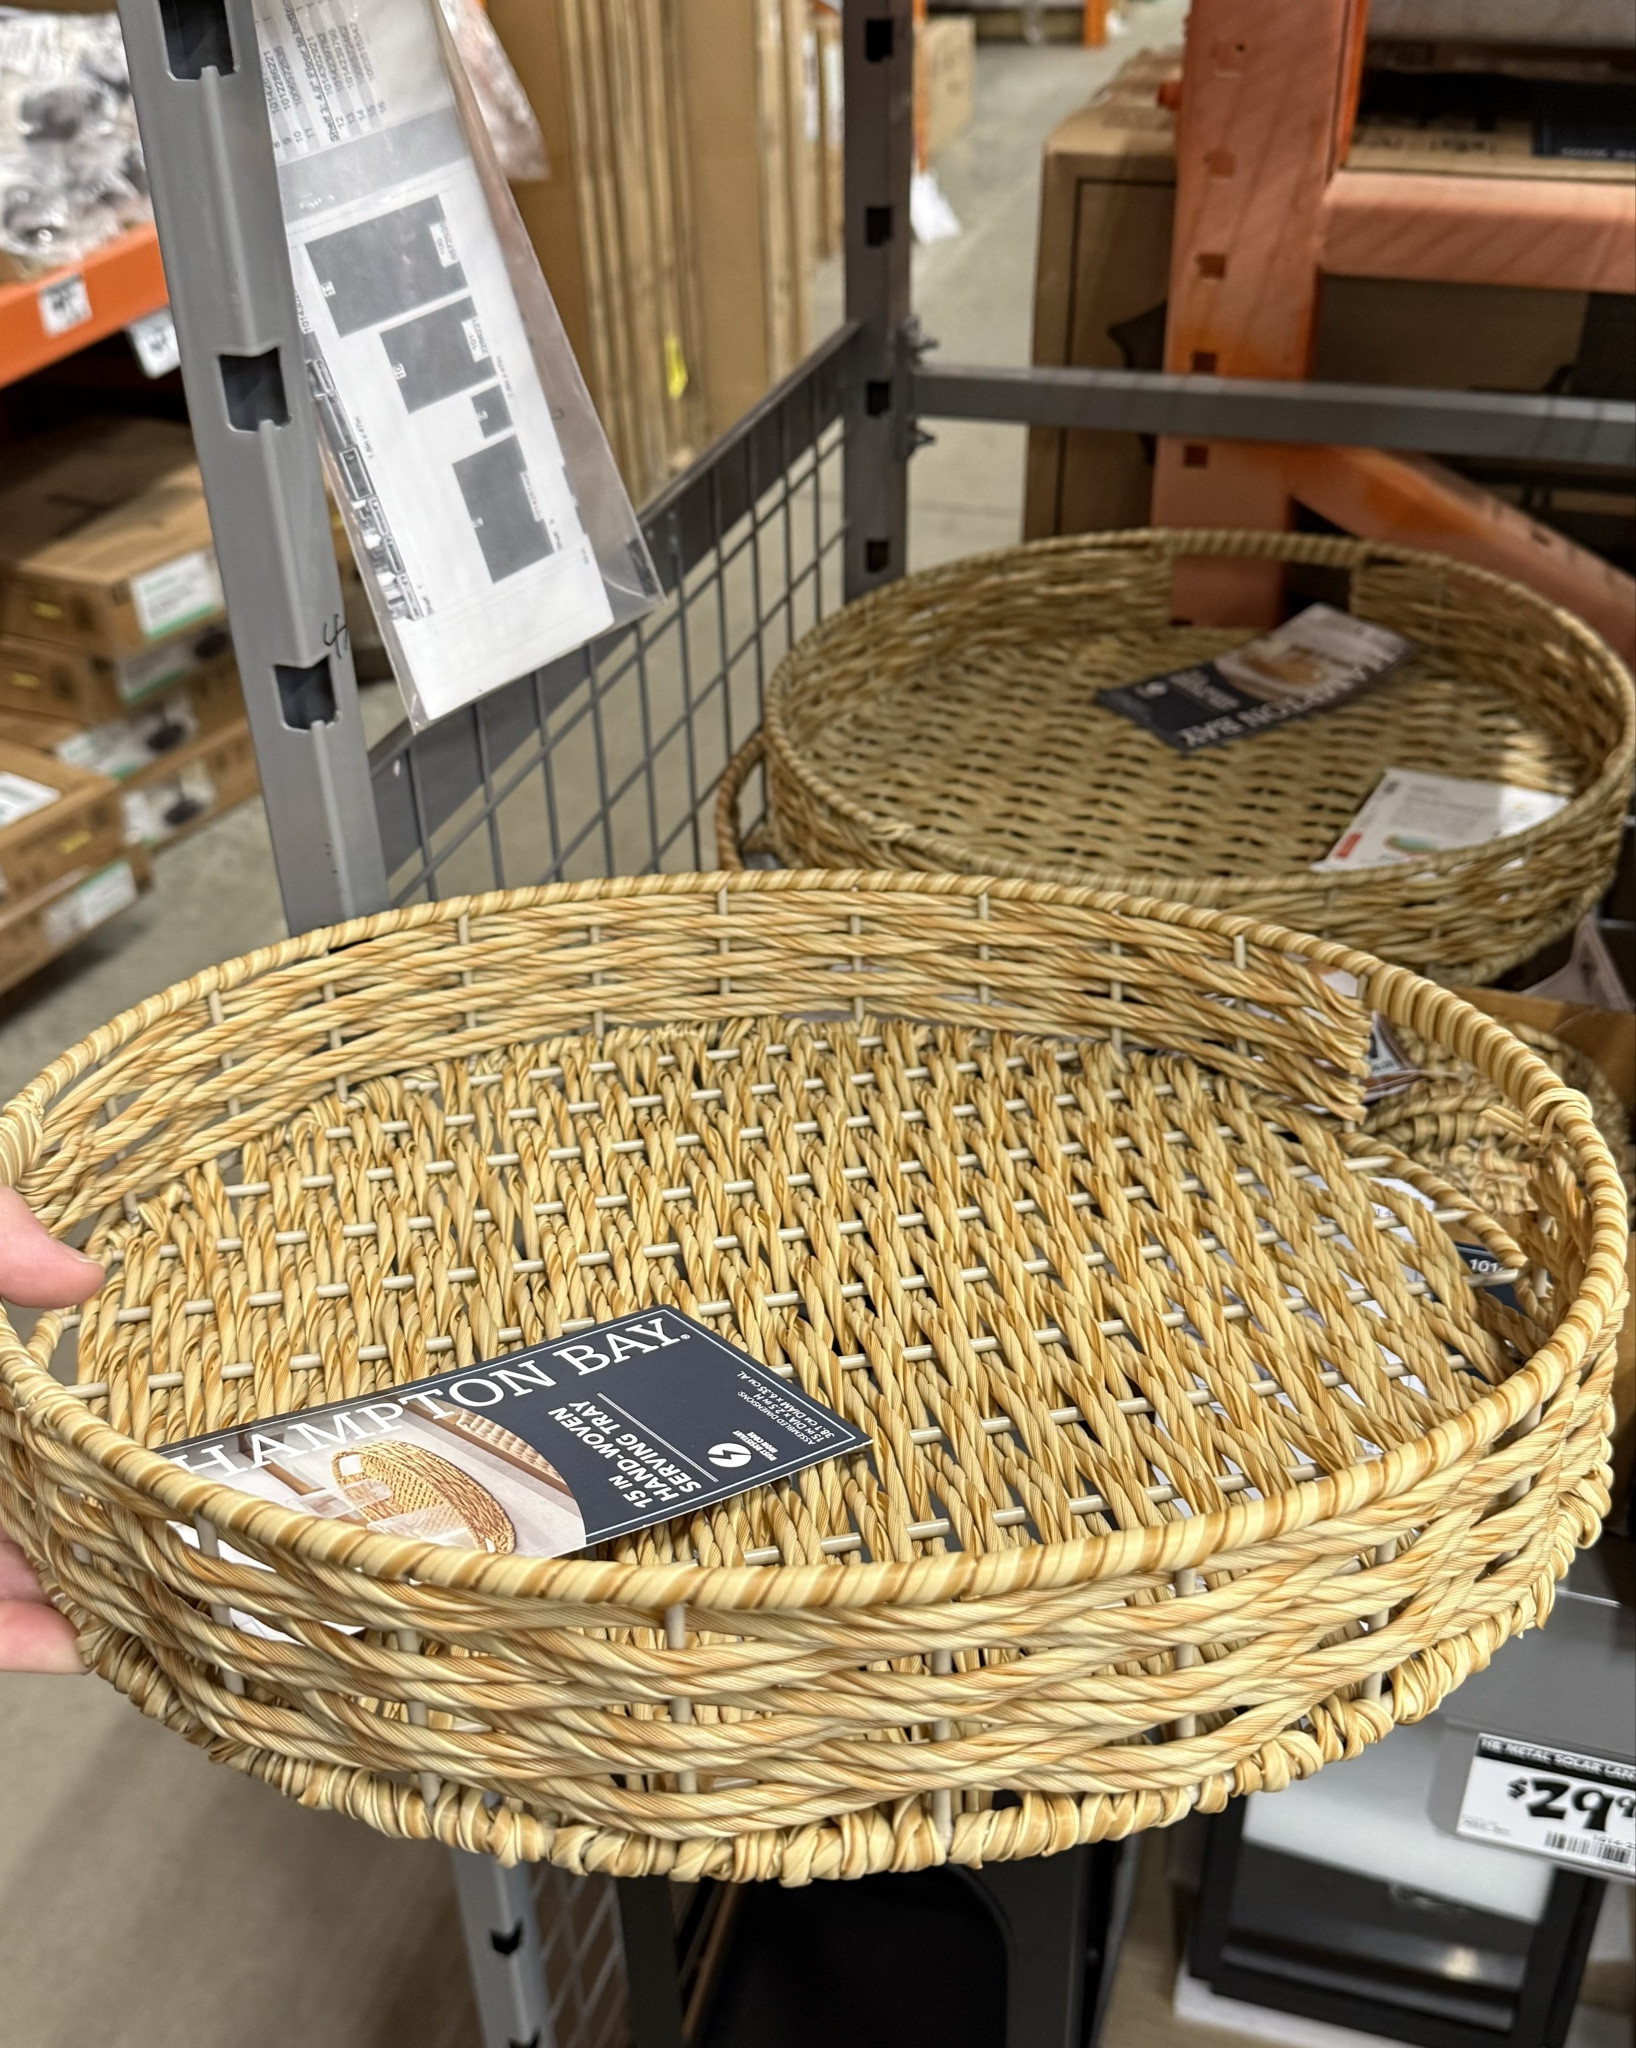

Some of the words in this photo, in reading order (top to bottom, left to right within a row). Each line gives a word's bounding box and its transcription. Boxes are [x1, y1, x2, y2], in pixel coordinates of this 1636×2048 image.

[292, 131, 303, 143] 10
[168, 1359, 557, 1478] HAMPTON
[552, 1318, 681, 1376] BAY
[757, 1386, 778, 1399] 6.35
[769, 1404, 786, 1414] 2.5
[568, 1401, 621, 1435] TRAY
[788, 1417, 807, 1430] DIA
[776, 1418, 816, 1445] ASSEMBLED
[811, 1432, 825, 1443] 15
[815, 1425, 835, 1438] 38.1
[548, 1407, 680, 1502] HAND-WOVEN
[615, 1433, 702, 1493] SERVING
[608, 1474, 633, 1490] IN
[622, 1490, 653, 1508] 15
[1505, 1743, 1552, 1763] METAL
[1554, 1752, 1603, 1775] SOLAR
